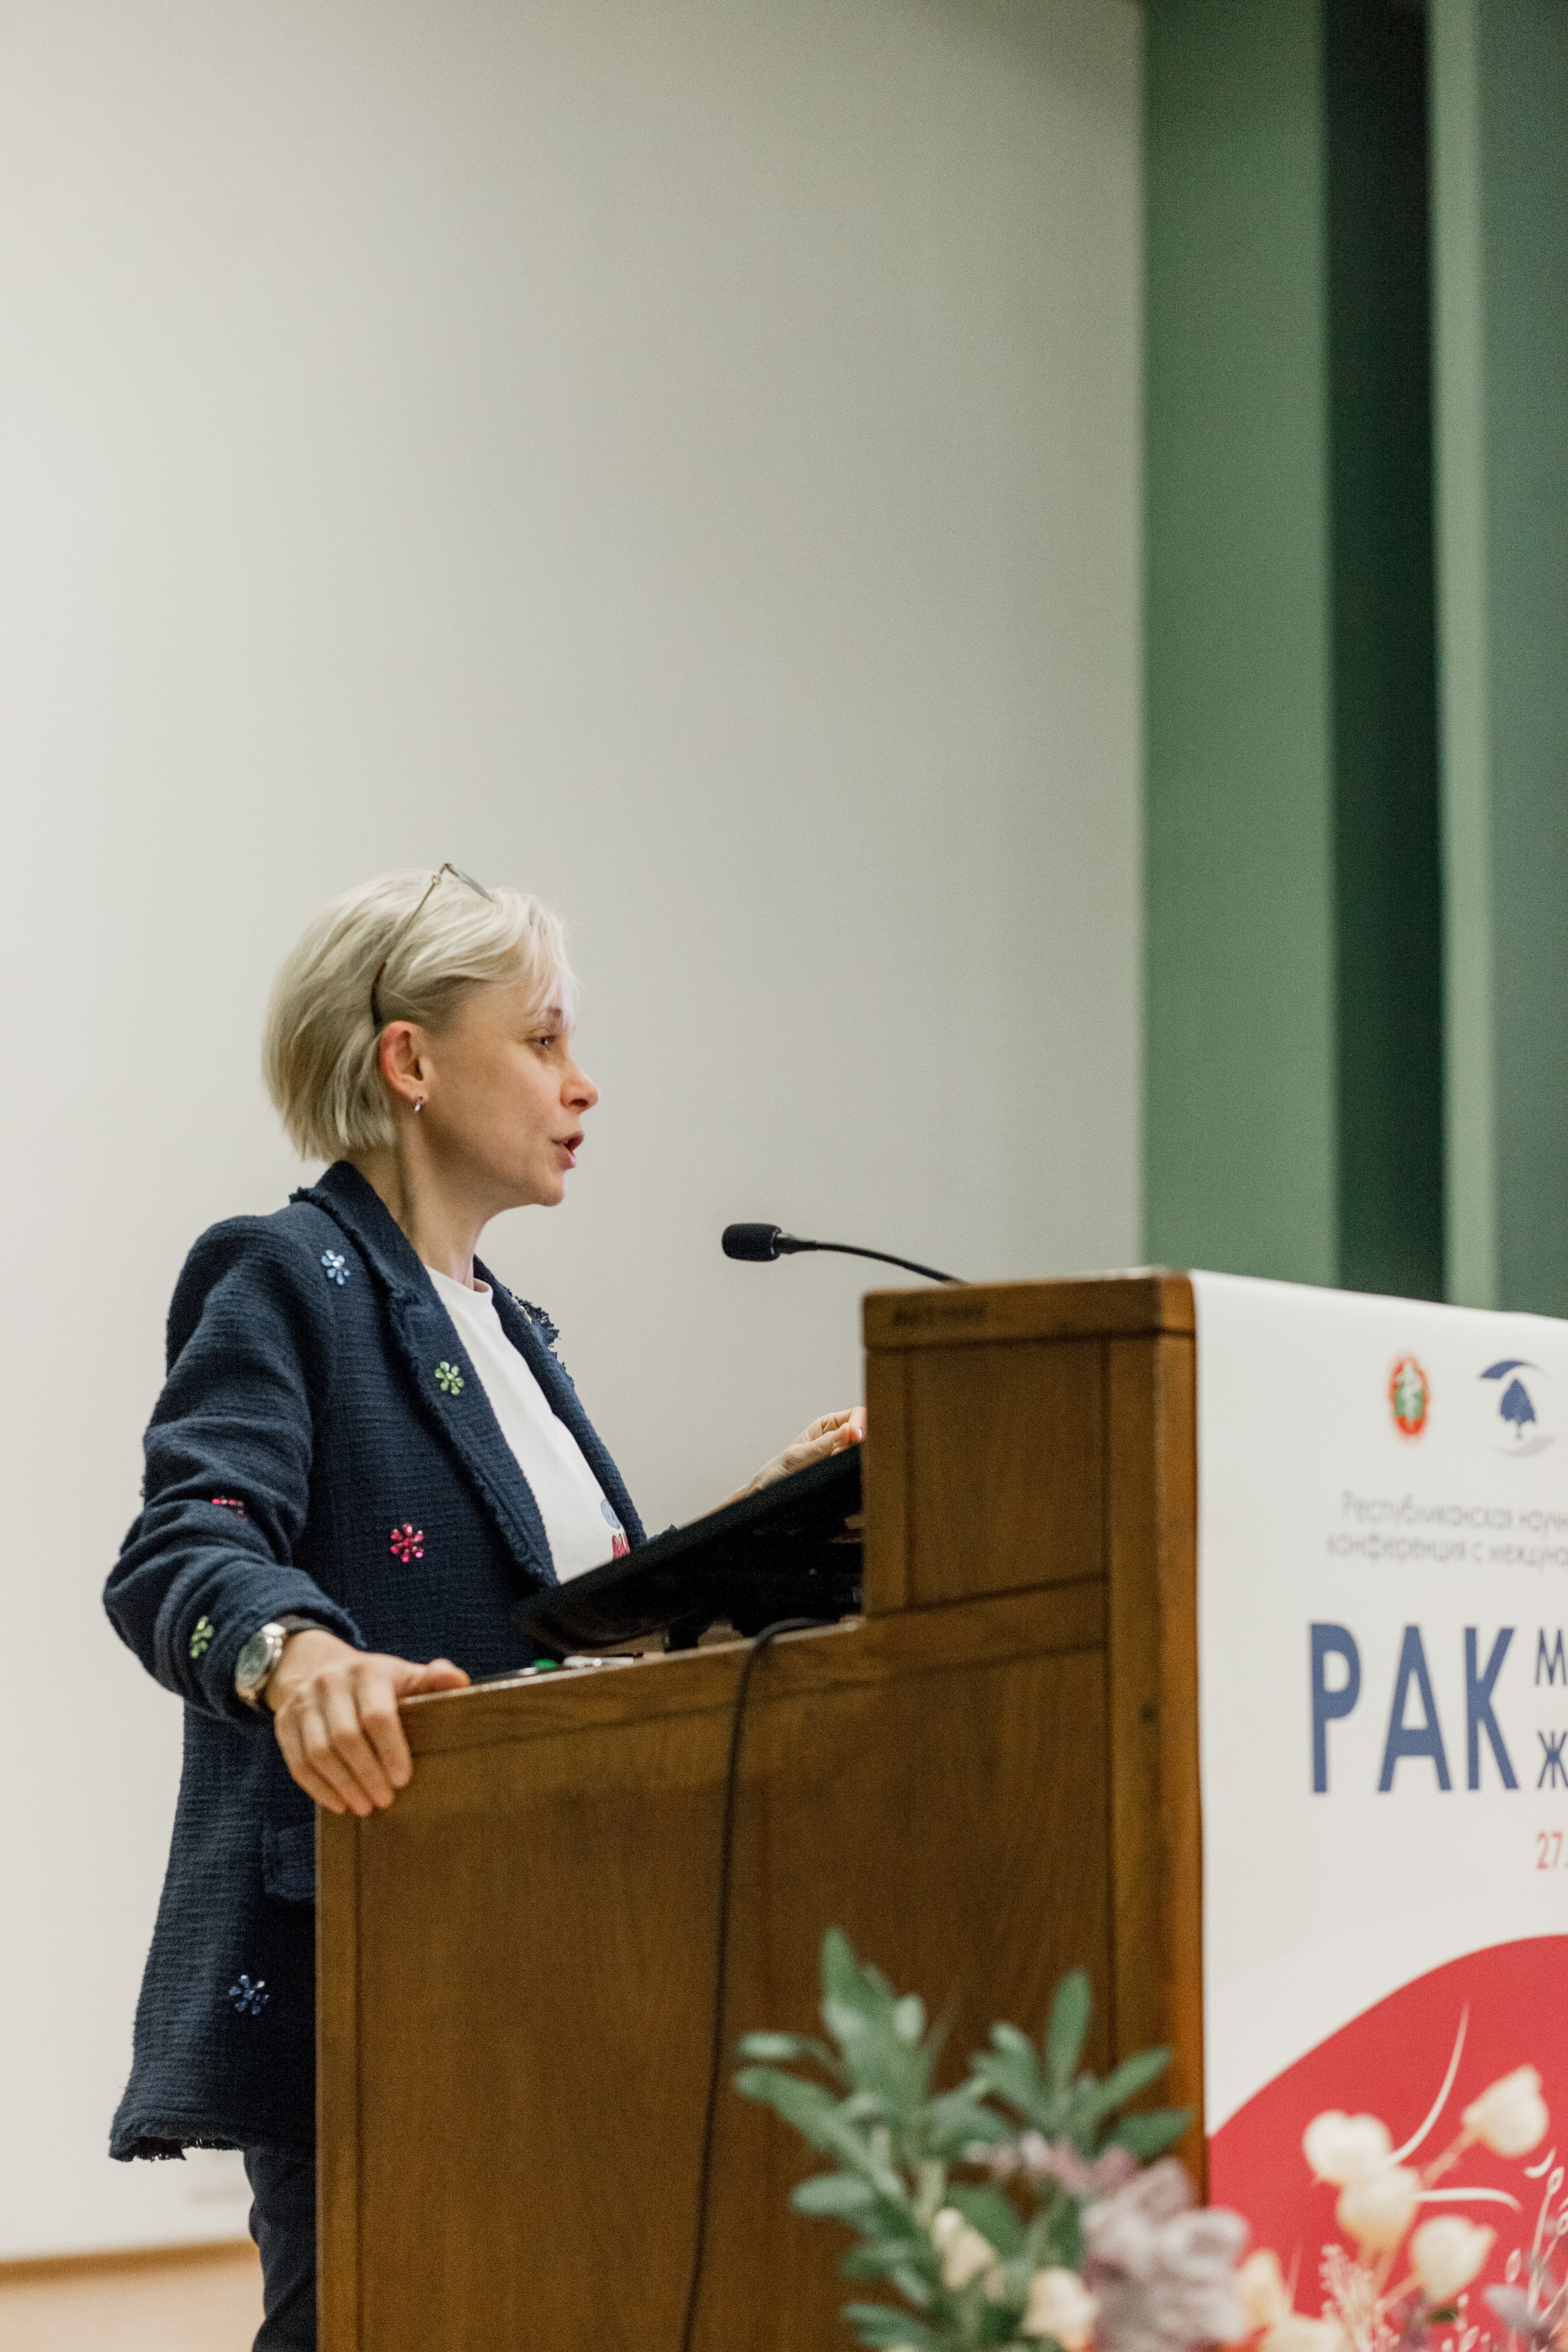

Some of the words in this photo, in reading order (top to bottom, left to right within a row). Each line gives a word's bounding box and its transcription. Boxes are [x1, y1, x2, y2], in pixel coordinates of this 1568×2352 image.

[1471, 1541, 1483, 1563] с
[1536, 1629, 1568, 1685] М
[1310, 1623, 1519, 1793] РАК
[1537, 1731, 1568, 1788] Ж
